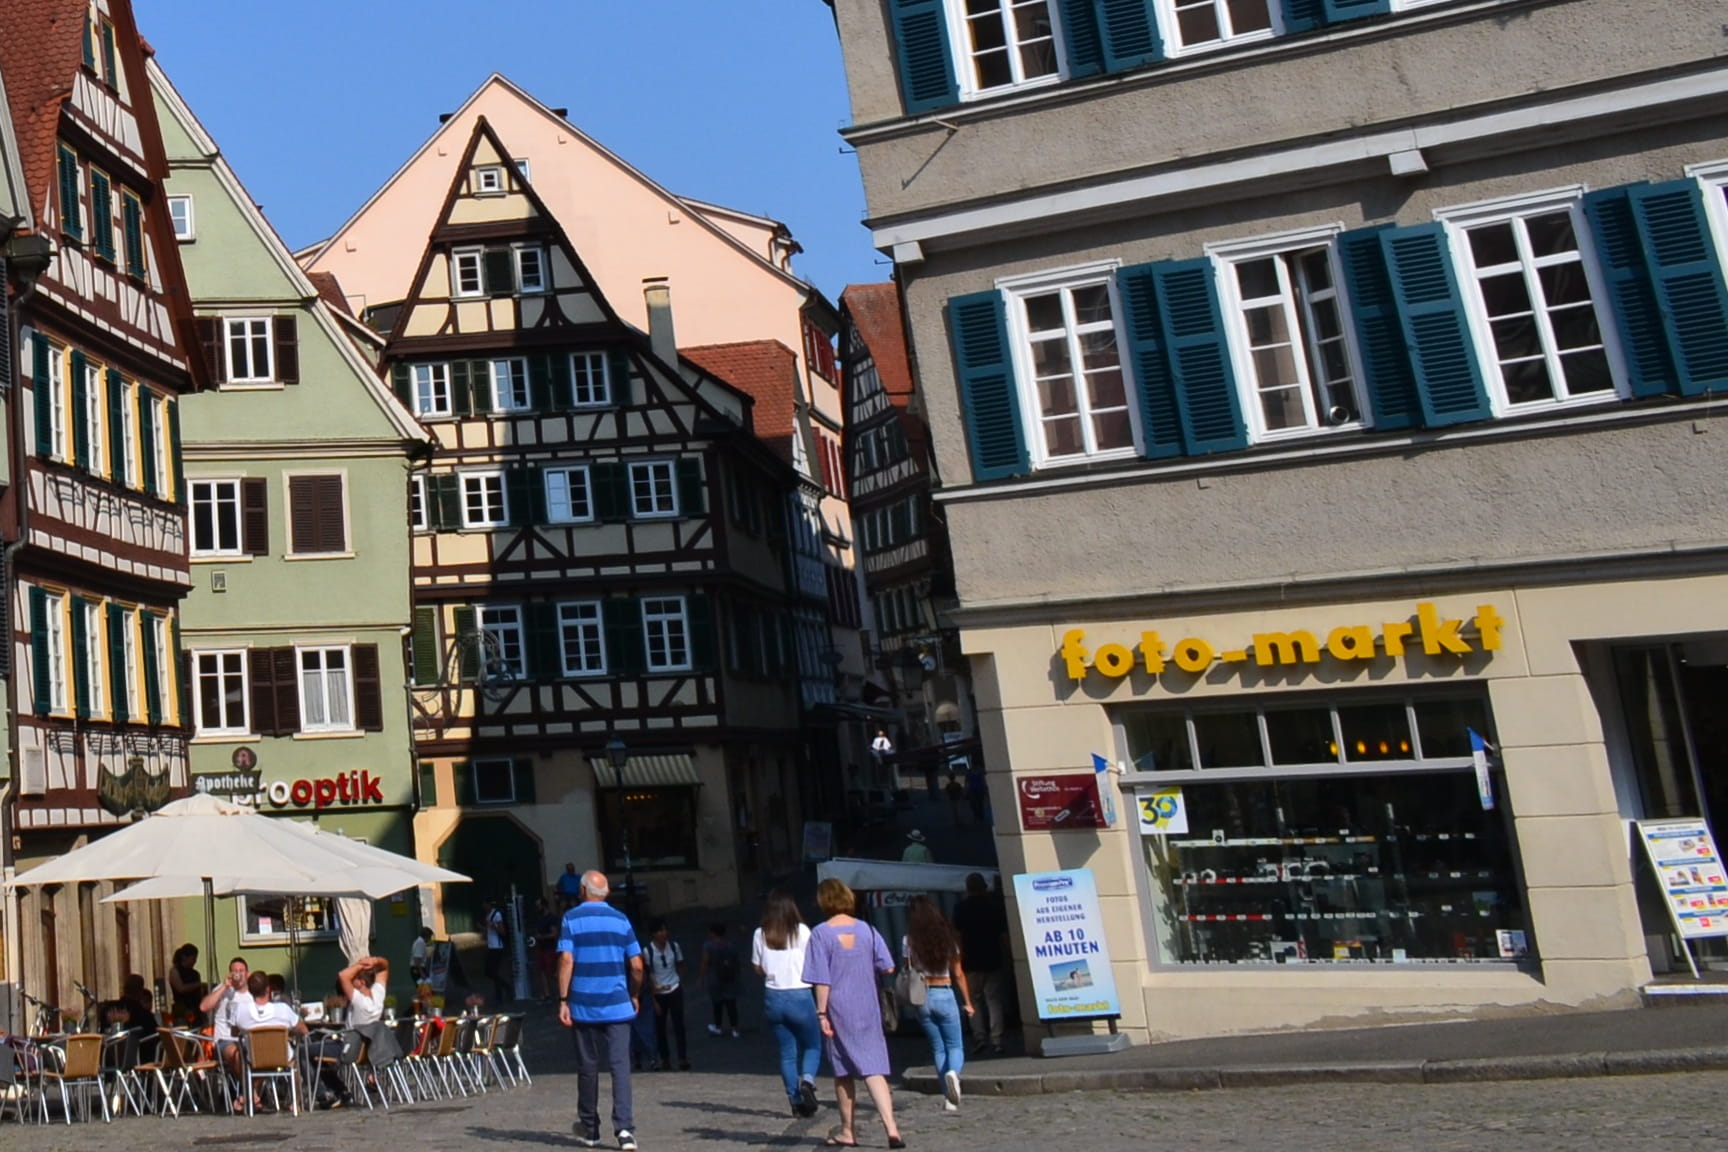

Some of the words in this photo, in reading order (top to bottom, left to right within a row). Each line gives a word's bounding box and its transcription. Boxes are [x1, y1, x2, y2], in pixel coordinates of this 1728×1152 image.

[1061, 603, 1505, 679] foto-markt
[195, 775, 255, 793] Apotheke
[1139, 795, 1178, 825] 30
[1036, 906, 1050, 914] AUS
[1052, 904, 1083, 913] EIGENER
[1036, 913, 1086, 924] HERSTELLUNG
[1044, 930, 1063, 943] AB
[1068, 928, 1085, 941] 10
[1035, 941, 1099, 958] MINUTEN
